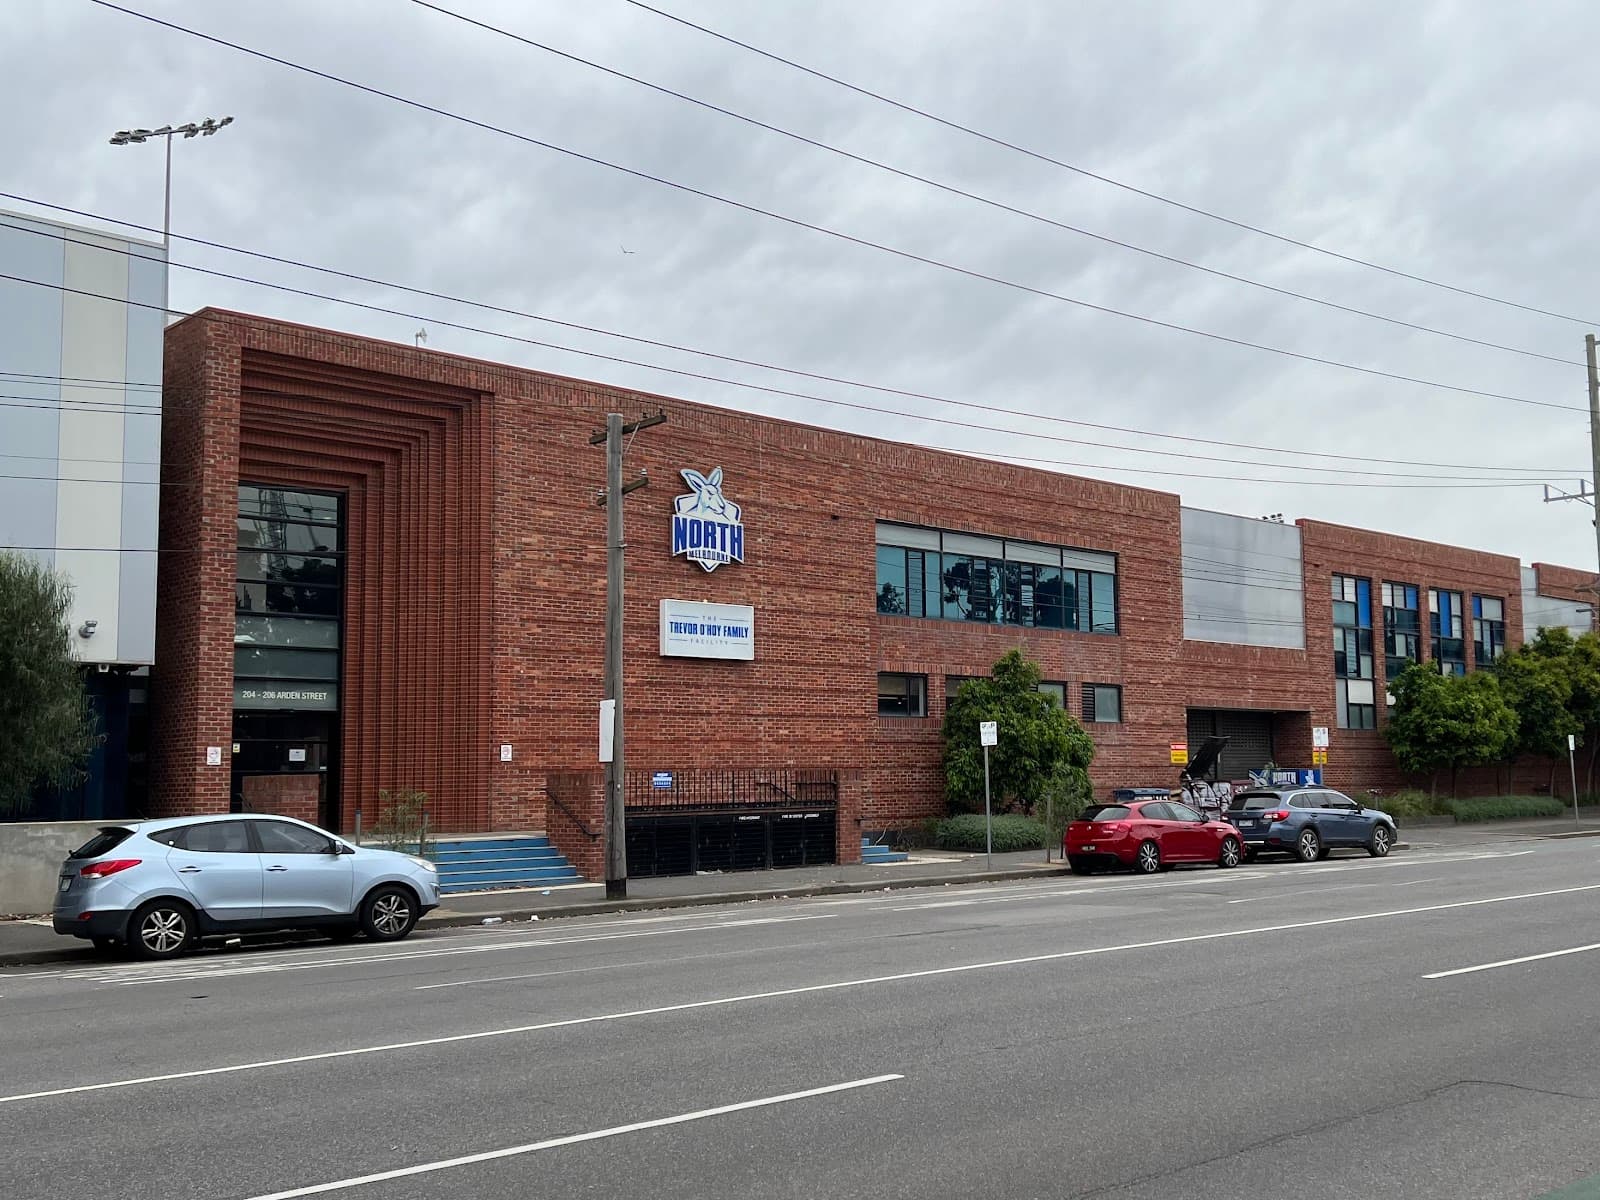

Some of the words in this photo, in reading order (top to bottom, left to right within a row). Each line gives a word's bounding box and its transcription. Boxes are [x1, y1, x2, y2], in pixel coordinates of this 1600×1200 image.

[673, 516, 744, 561] NORTH
[688, 549, 729, 562] MELBOURNE
[669, 621, 698, 635] TREVOR
[699, 623, 721, 637] O'HOY
[723, 625, 749, 638] FAMILY
[690, 638, 728, 646] FACILITY
[242, 690, 256, 699] 204
[262, 691, 276, 699] 206
[276, 691, 300, 700] ARDEN
[301, 692, 328, 700] STREET
[1272, 771, 1297, 785] NORTH
